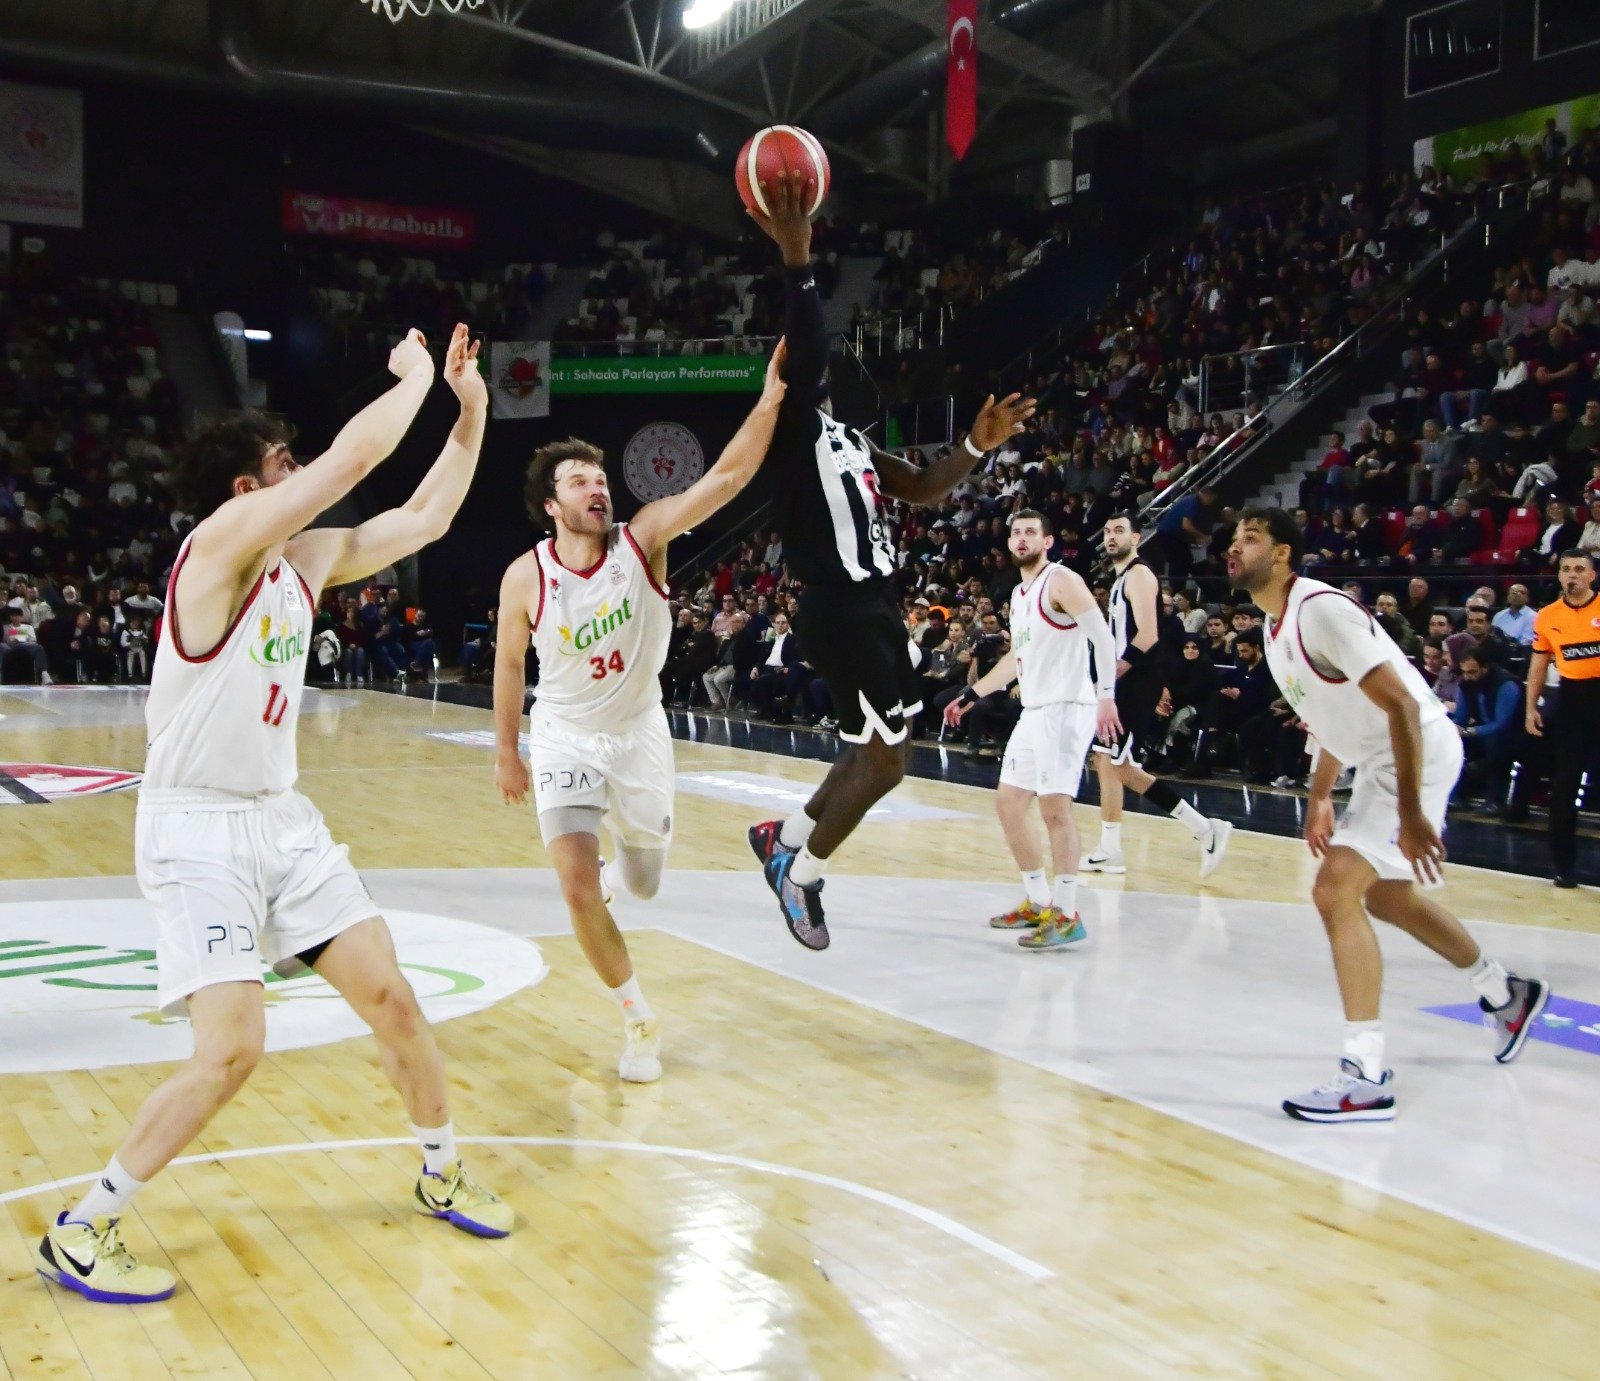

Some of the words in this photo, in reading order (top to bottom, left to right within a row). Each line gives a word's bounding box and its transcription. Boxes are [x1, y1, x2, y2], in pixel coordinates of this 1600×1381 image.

[338, 208, 464, 238] pizzabulls
[573, 368, 619, 381] Sahada
[622, 367, 676, 382] Parlayan
[574, 597, 632, 650] Glint
[589, 649, 625, 680] 34
[262, 681, 288, 727] 11
